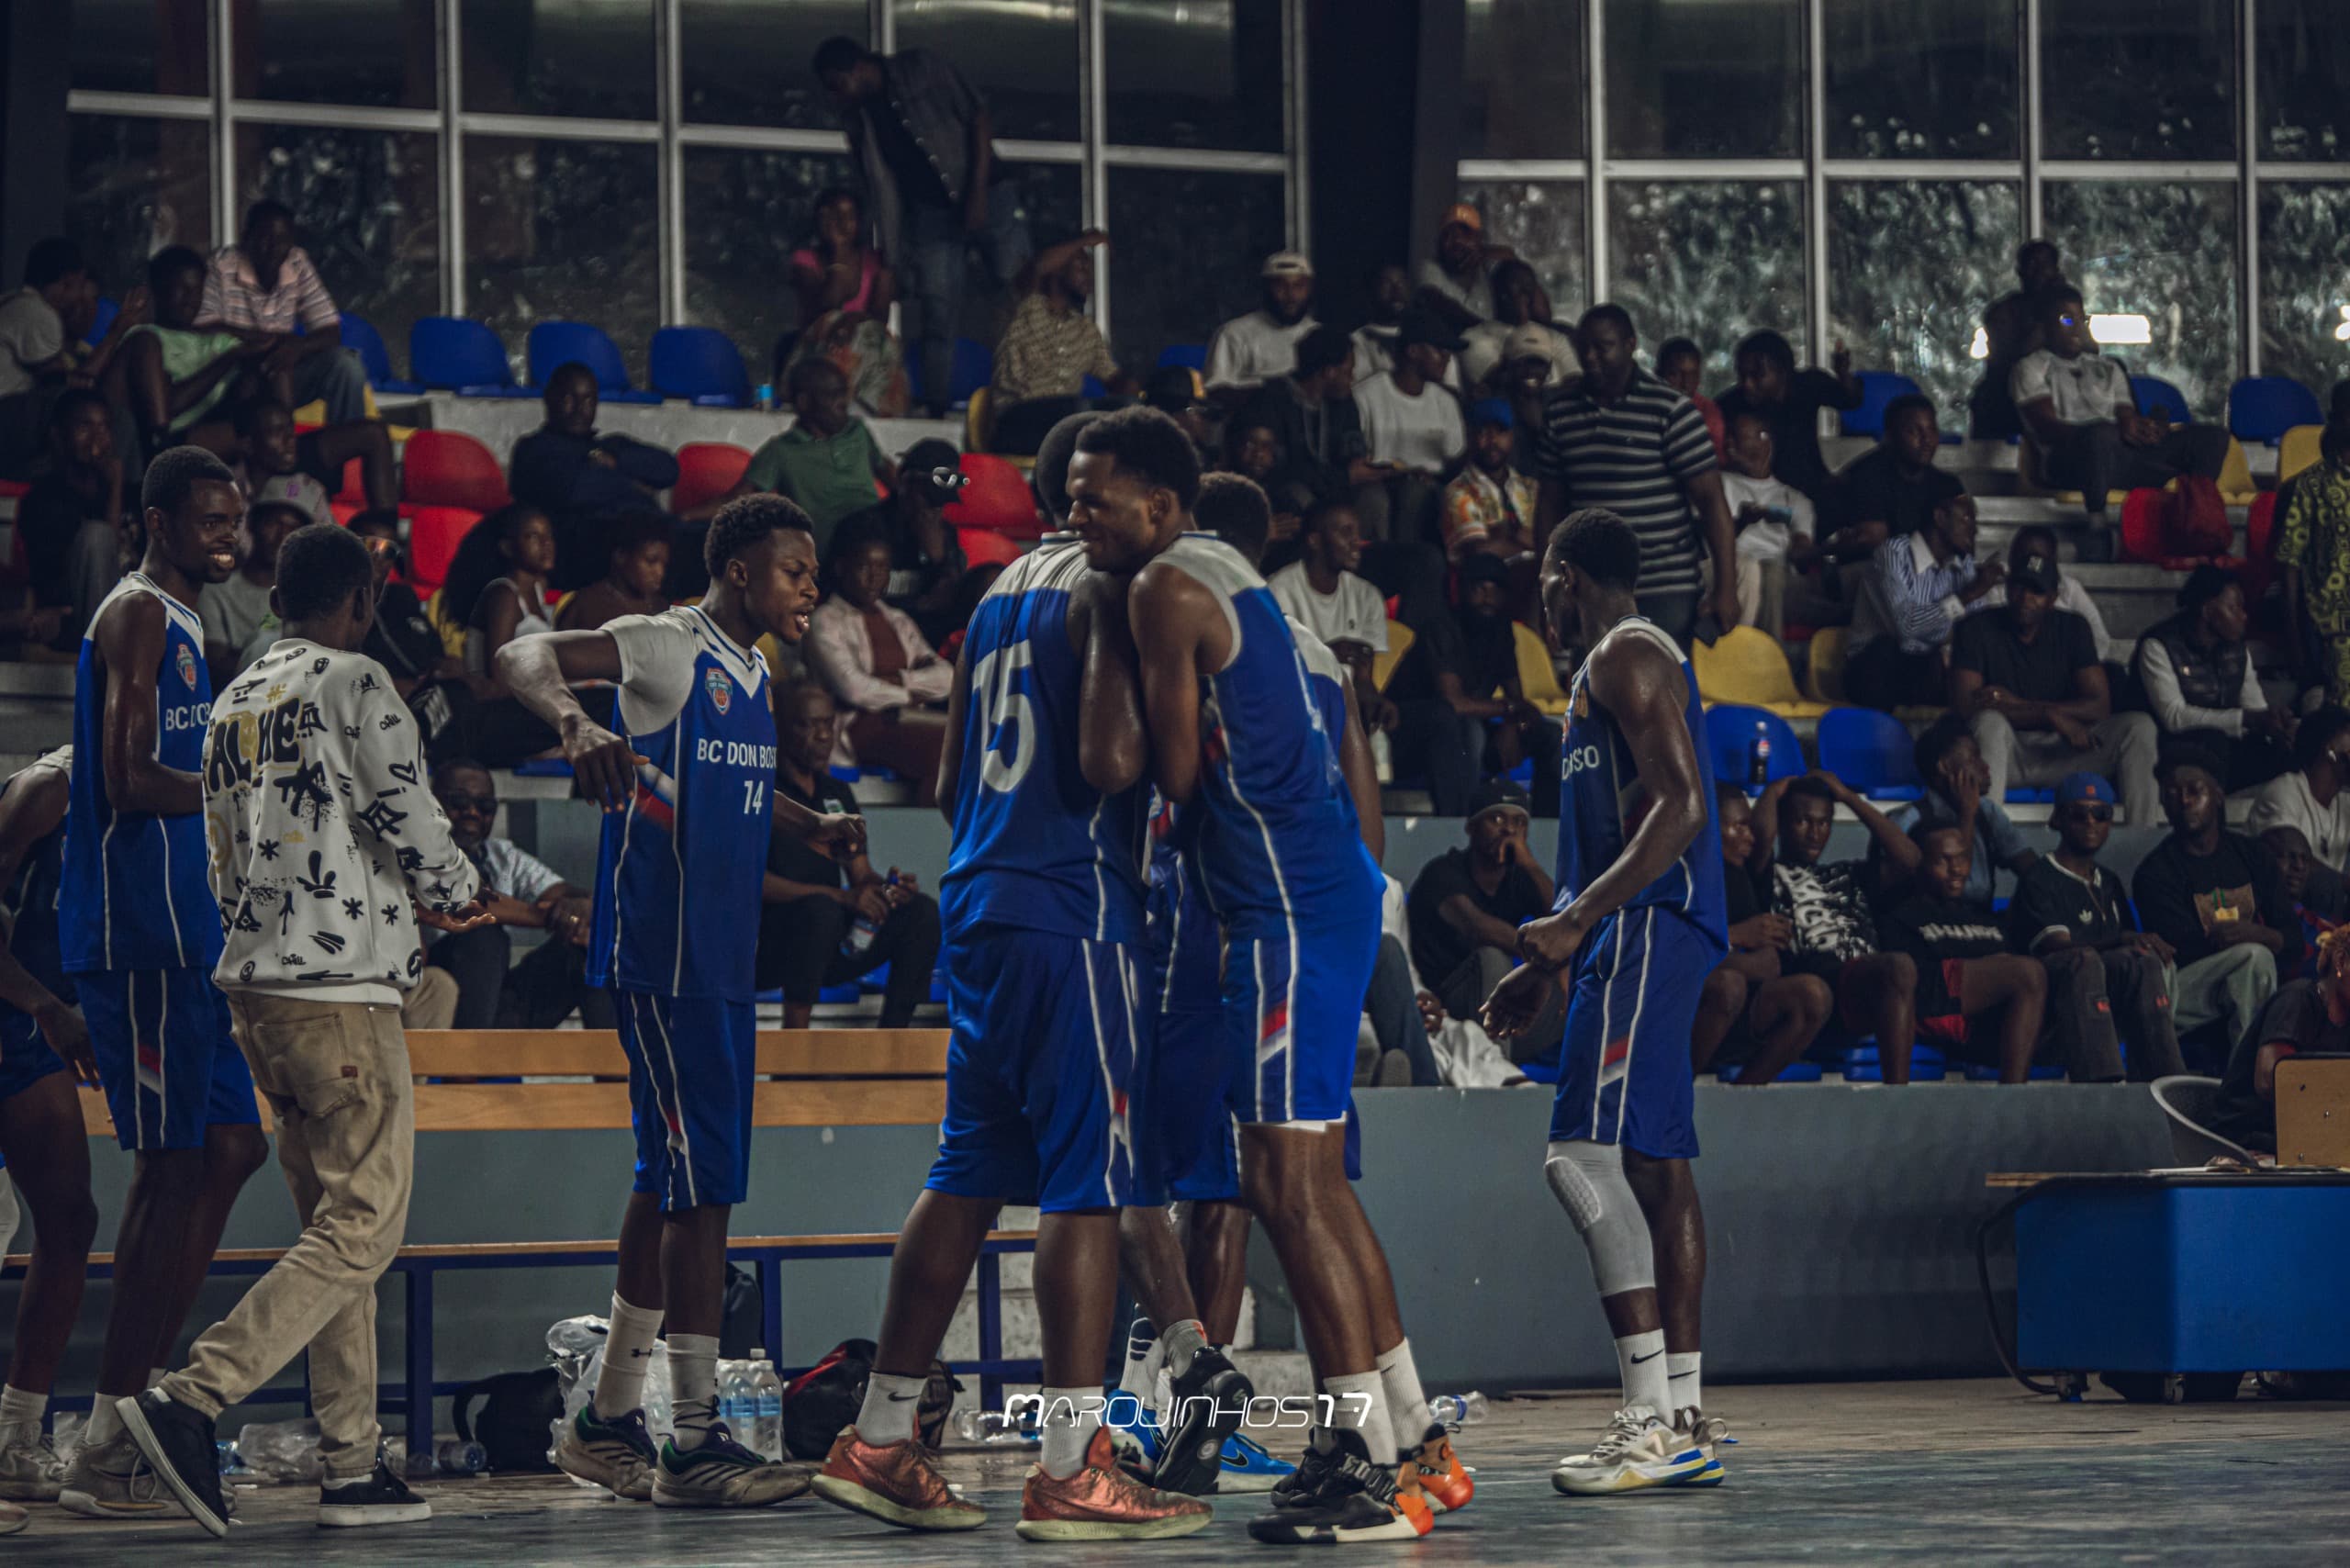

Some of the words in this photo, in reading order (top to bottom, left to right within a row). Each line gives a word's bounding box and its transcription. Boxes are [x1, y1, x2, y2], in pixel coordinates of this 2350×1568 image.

[165, 706, 188, 731] BC
[971, 639, 1035, 797] 15
[697, 738, 723, 763] BC
[727, 741, 757, 767] DON
[744, 779, 764, 815] 14
